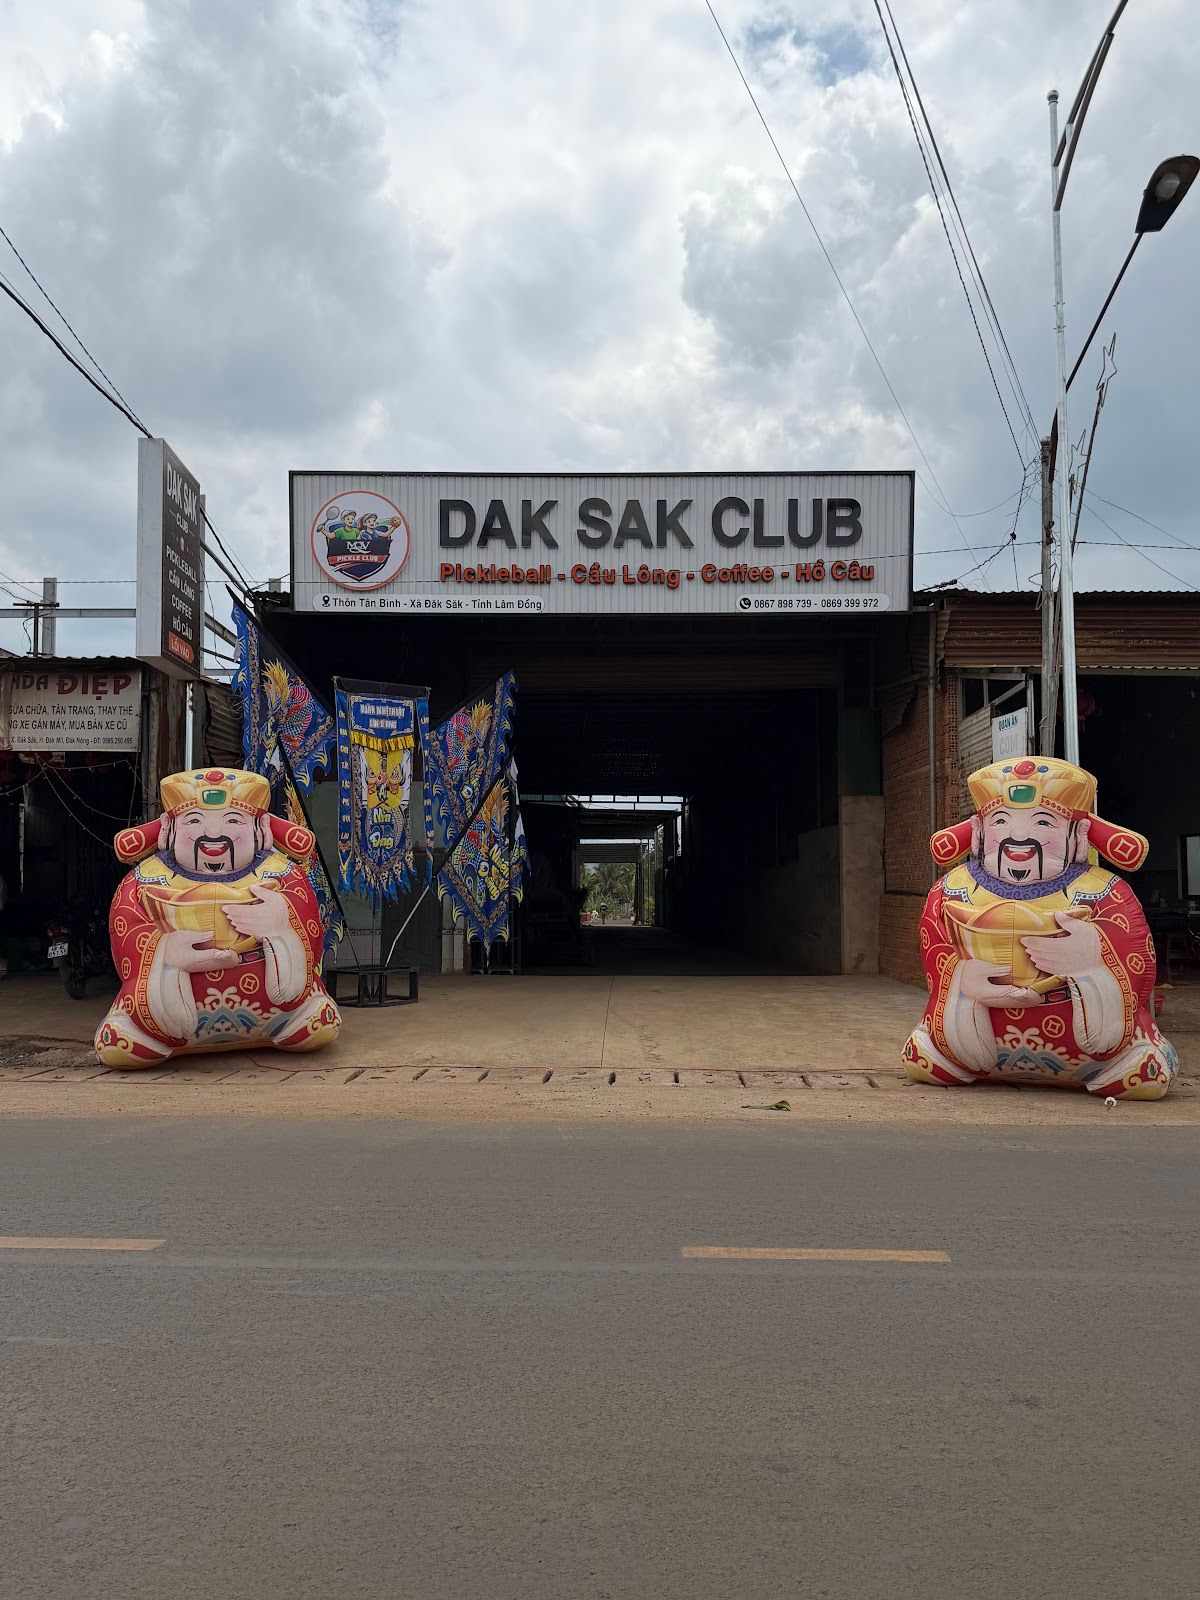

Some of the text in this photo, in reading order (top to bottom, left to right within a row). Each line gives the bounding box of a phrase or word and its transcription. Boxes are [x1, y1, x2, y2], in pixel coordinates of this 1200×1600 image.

[166, 462, 198, 525] DAK SAK
[176, 513, 188, 534] CLUB
[440, 496, 863, 549] DAK SAK CLUB
[346, 541, 371, 554] MQV
[166, 545, 198, 584] PICKLEBALL
[440, 563, 552, 584] Pickleball
[572, 562, 616, 584] Cầu
[622, 564, 680, 589] Lông
[700, 564, 774, 583] Coffee
[796, 560, 826, 582] Hồ
[831, 562, 875, 582] Câu
[180, 580, 194, 600] LÔNG
[172, 594, 192, 620] COFFEE
[332, 598, 356, 608] Thôn
[359, 598, 376, 608] Tân
[495, 600, 514, 608] Lâm
[754, 598, 775, 608] 0867
[776, 598, 794, 608] 898
[796, 598, 812, 608] 739
[820, 598, 842, 608] 0869
[844, 598, 861, 608] 399
[862, 598, 879, 608] 972
[56, 674, 132, 700] ĐIỆP
[98, 706, 117, 715] THAY
[20, 720, 30, 730] XE
[68, 720, 85, 730] MUA
[87, 718, 103, 730] BÁN
[104, 720, 115, 730] XE
[116, 718, 128, 730] CŨ
